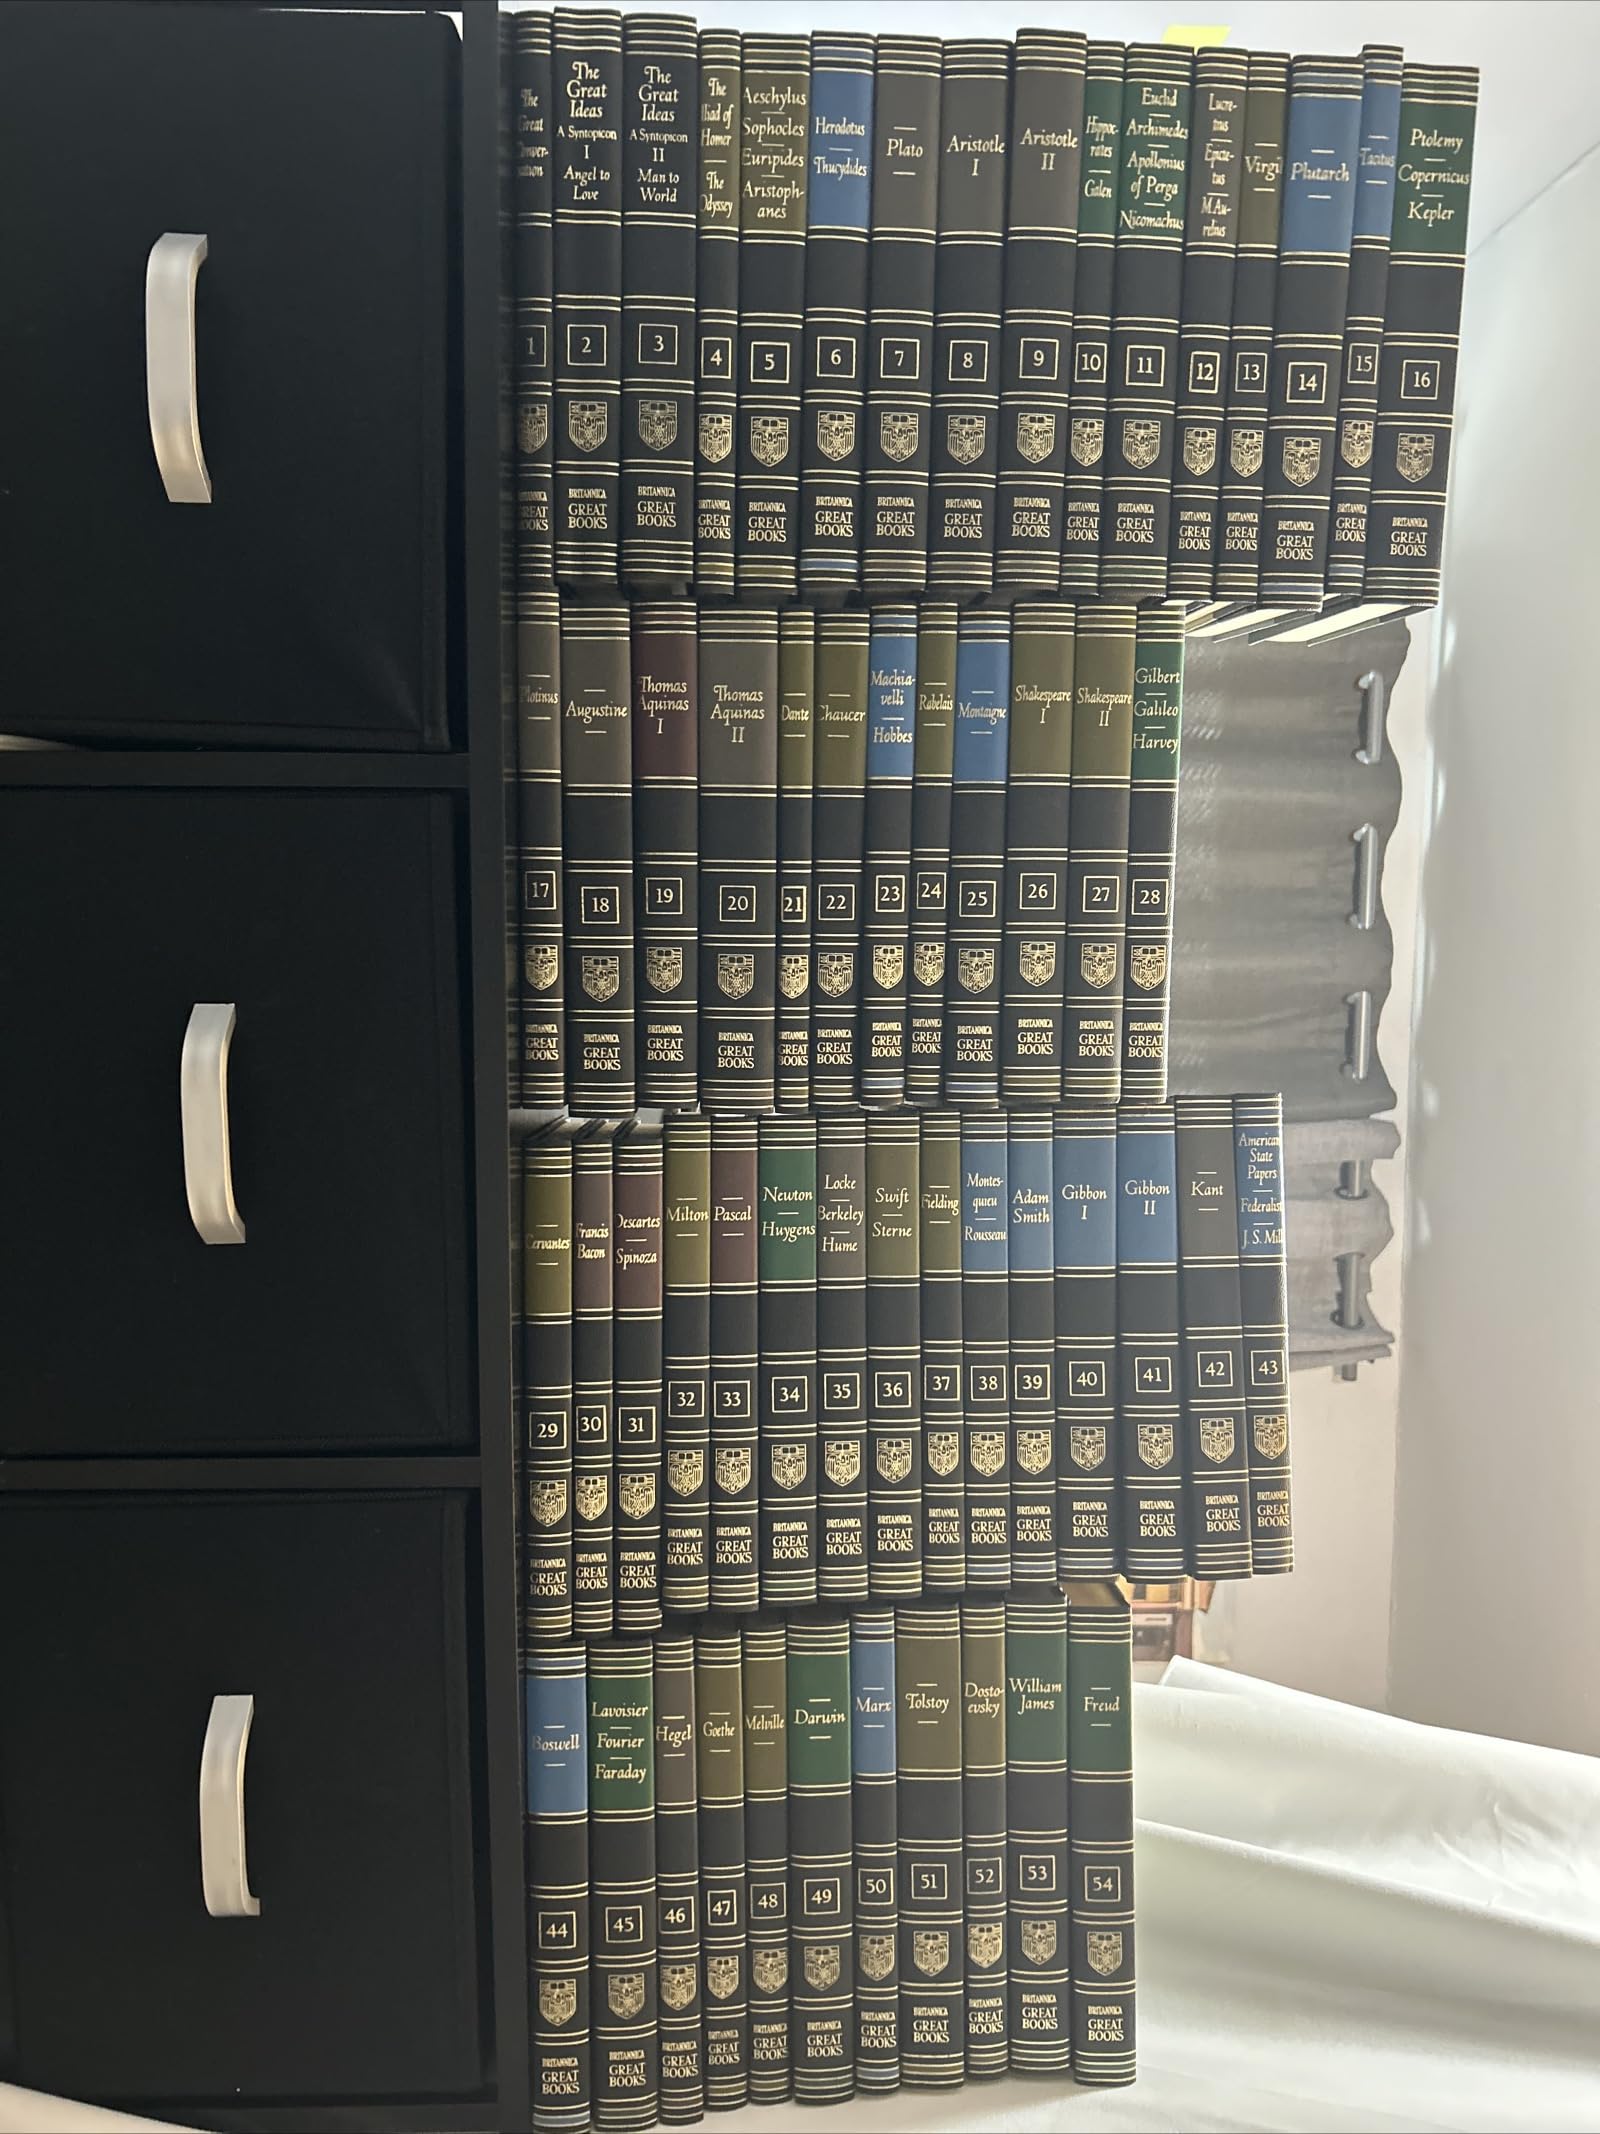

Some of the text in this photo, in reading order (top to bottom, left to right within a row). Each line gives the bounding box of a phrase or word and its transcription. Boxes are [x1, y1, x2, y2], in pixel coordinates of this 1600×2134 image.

[571, 61, 600, 79] The
[643, 66, 671, 84] The
[566, 80, 607, 98] Great
[638, 85, 679, 102] Great
[708, 78, 726, 96] The
[744, 86, 806, 111] Aeschylus
[1141, 87, 1177, 106] Euclid
[570, 100, 603, 118] Ideas
[641, 104, 675, 121] Ideas
[557, 126, 617, 141] A Syntopicon
[743, 118, 804, 142] Sophocles
[816, 117, 865, 135] Herodotus
[1126, 119, 1189, 140] Archimedes
[629, 130, 688, 143] A Syntopicon
[702, 131, 732, 146] Homer
[947, 135, 1005, 154] Aristotle
[1020, 128, 1078, 148] Aristotle
[1410, 128, 1463, 154] Ptolemy
[584, 145, 589, 159] I
[653, 148, 664, 161] II
[886, 139, 923, 158] Plato
[1090, 145, 1112, 158] rates
[1041, 153, 1056, 170] II
[1127, 151, 1185, 174] Apollonius
[1360, 148, 1395, 167] Tacitus
[814, 157, 867, 181] Thucydides
[972, 159, 979, 176] I
[1245, 156, 1283, 181] Virgil
[1290, 163, 1350, 182] Plutarch
[564, 166, 610, 186] Angel to
[637, 169, 679, 183] Man to
[706, 171, 724, 189] The
[1398, 164, 1469, 189] Copernicus
[573, 186, 598, 200] Love
[640, 187, 677, 202] World
[744, 181, 805, 205] Aristoph-
[1085, 179, 1112, 198] Galen
[1131, 176, 1178, 201] of Perga
[757, 205, 786, 218] anes
[1408, 202, 1454, 227] Kepler
[1120, 210, 1183, 230] Nicomachus
[581, 337, 591, 352] 2
[654, 335, 664, 352] 3
[765, 354, 775, 370] 5
[895, 350, 904, 366] 7
[1033, 350, 1044, 366] 9
[1136, 357, 1153, 373] 11
[1299, 374, 1317, 392] 14
[1413, 371, 1430, 387] 16
[638, 486, 675, 497] BRITANNICA
[638, 501, 676, 513] GREAT
[637, 515, 676, 527] BOOKS
[871, 669, 916, 686] Machia-
[1135, 667, 1180, 684] Gilbert
[639, 675, 687, 693] Thomas
[713, 685, 763, 702] Thomas
[880, 690, 904, 706] velli
[1015, 685, 1071, 708] Shakespeare
[1077, 688, 1132, 710] Shakespeare
[639, 695, 689, 717] Aquinas
[919, 694, 953, 711] Rabelais
[1134, 700, 1178, 717] Galileo
[566, 701, 628, 723] Augustine
[711, 703, 765, 725] Aquinas
[782, 705, 810, 721] Dante
[958, 703, 1007, 725] Montaigne
[1040, 708, 1046, 723] I
[1099, 711, 1109, 726] II
[657, 719, 663, 734] I
[731, 727, 745, 742] II
[873, 727, 913, 743] Hobbes
[1133, 734, 1178, 754] Harvey
[657, 889, 673, 903] 19
[968, 892, 987, 906] 25
[1028, 884, 1048, 898] 26
[1092, 887, 1110, 901] 27
[592, 897, 609, 912] 18
[727, 896, 748, 910] 20
[826, 896, 846, 910] 22
[1018, 1019, 1053, 1028] BRITANNICA
[1018, 1032, 1053, 1043] GREAT
[1018, 1044, 1053, 1055] BOOKS
[1250, 1149, 1273, 1163] State
[824, 1174, 856, 1191] Locke
[967, 1173, 1004, 1188] Montes-
[1247, 1165, 1277, 1185] Papers
[764, 1187, 813, 1202] Newton
[1062, 1184, 1107, 1200] Gibbon
[1125, 1180, 1170, 1195] Gibbon
[1191, 1181, 1223, 1196] Kant
[876, 1188, 909, 1209] Swift
[1013, 1189, 1049, 1204] Adam
[714, 1205, 752, 1221] Pascal
[922, 1194, 959, 1216] Fielding
[973, 1197, 998, 1213] quieu
[1081, 1206, 1088, 1220] I
[1143, 1202, 1156, 1215] II
[666, 1207, 708, 1222] Milton
[818, 1206, 864, 1225] Berkeley
[1013, 1208, 1050, 1224] Smith
[576, 1224, 609, 1239] Francis
[762, 1222, 816, 1242] Huygens
[873, 1222, 912, 1237] Sterne
[964, 1226, 1007, 1241] Rousseau
[577, 1244, 605, 1259] Bacon
[822, 1237, 858, 1252] Hume
[616, 1249, 657, 1270] Spinoza
[1143, 1367, 1162, 1382] 41
[1206, 1362, 1225, 1377] 42
[1023, 1375, 1042, 1390] 39
[1076, 1372, 1097, 1387] 40
[780, 1387, 800, 1402] 34
[883, 1382, 903, 1397] 36
[677, 1392, 696, 1407] 32
[722, 1391, 741, 1407] 33
[878, 1515, 912, 1524] BRITANNICA
[878, 1529, 913, 1540] GREAT
[878, 1540, 913, 1551] BOOKS
[964, 1682, 1004, 1699] Dosto-
[1009, 1677, 1062, 1694] William
[592, 1702, 648, 1718] Lavoisier
[856, 1696, 892, 1713] Marx
[905, 1692, 949, 1713] Tolstoy
[968, 1699, 1000, 1718] evsky
[1017, 1697, 1054, 1715] James
[1084, 1696, 1120, 1712] Freud
[745, 1714, 784, 1730] Melville
[794, 1709, 846, 1725] Darwin
[656, 1724, 692, 1747] Hegel
[703, 1721, 735, 1737] Goethe
[597, 1733, 644, 1749] Fourier
[595, 1765, 647, 1784] Faraday
[921, 1874, 938, 1889] 51
[1028, 1866, 1047, 1881] 53
[812, 1889, 832, 1904] 49
[712, 1900, 731, 1916] 47
[546, 1923, 568, 1938] 44
[613, 1917, 634, 1932] 45
[914, 2007, 948, 2018] BRITANNICA
[913, 2021, 949, 2031] GREAT
[913, 2031, 950, 2043] BOOKS
